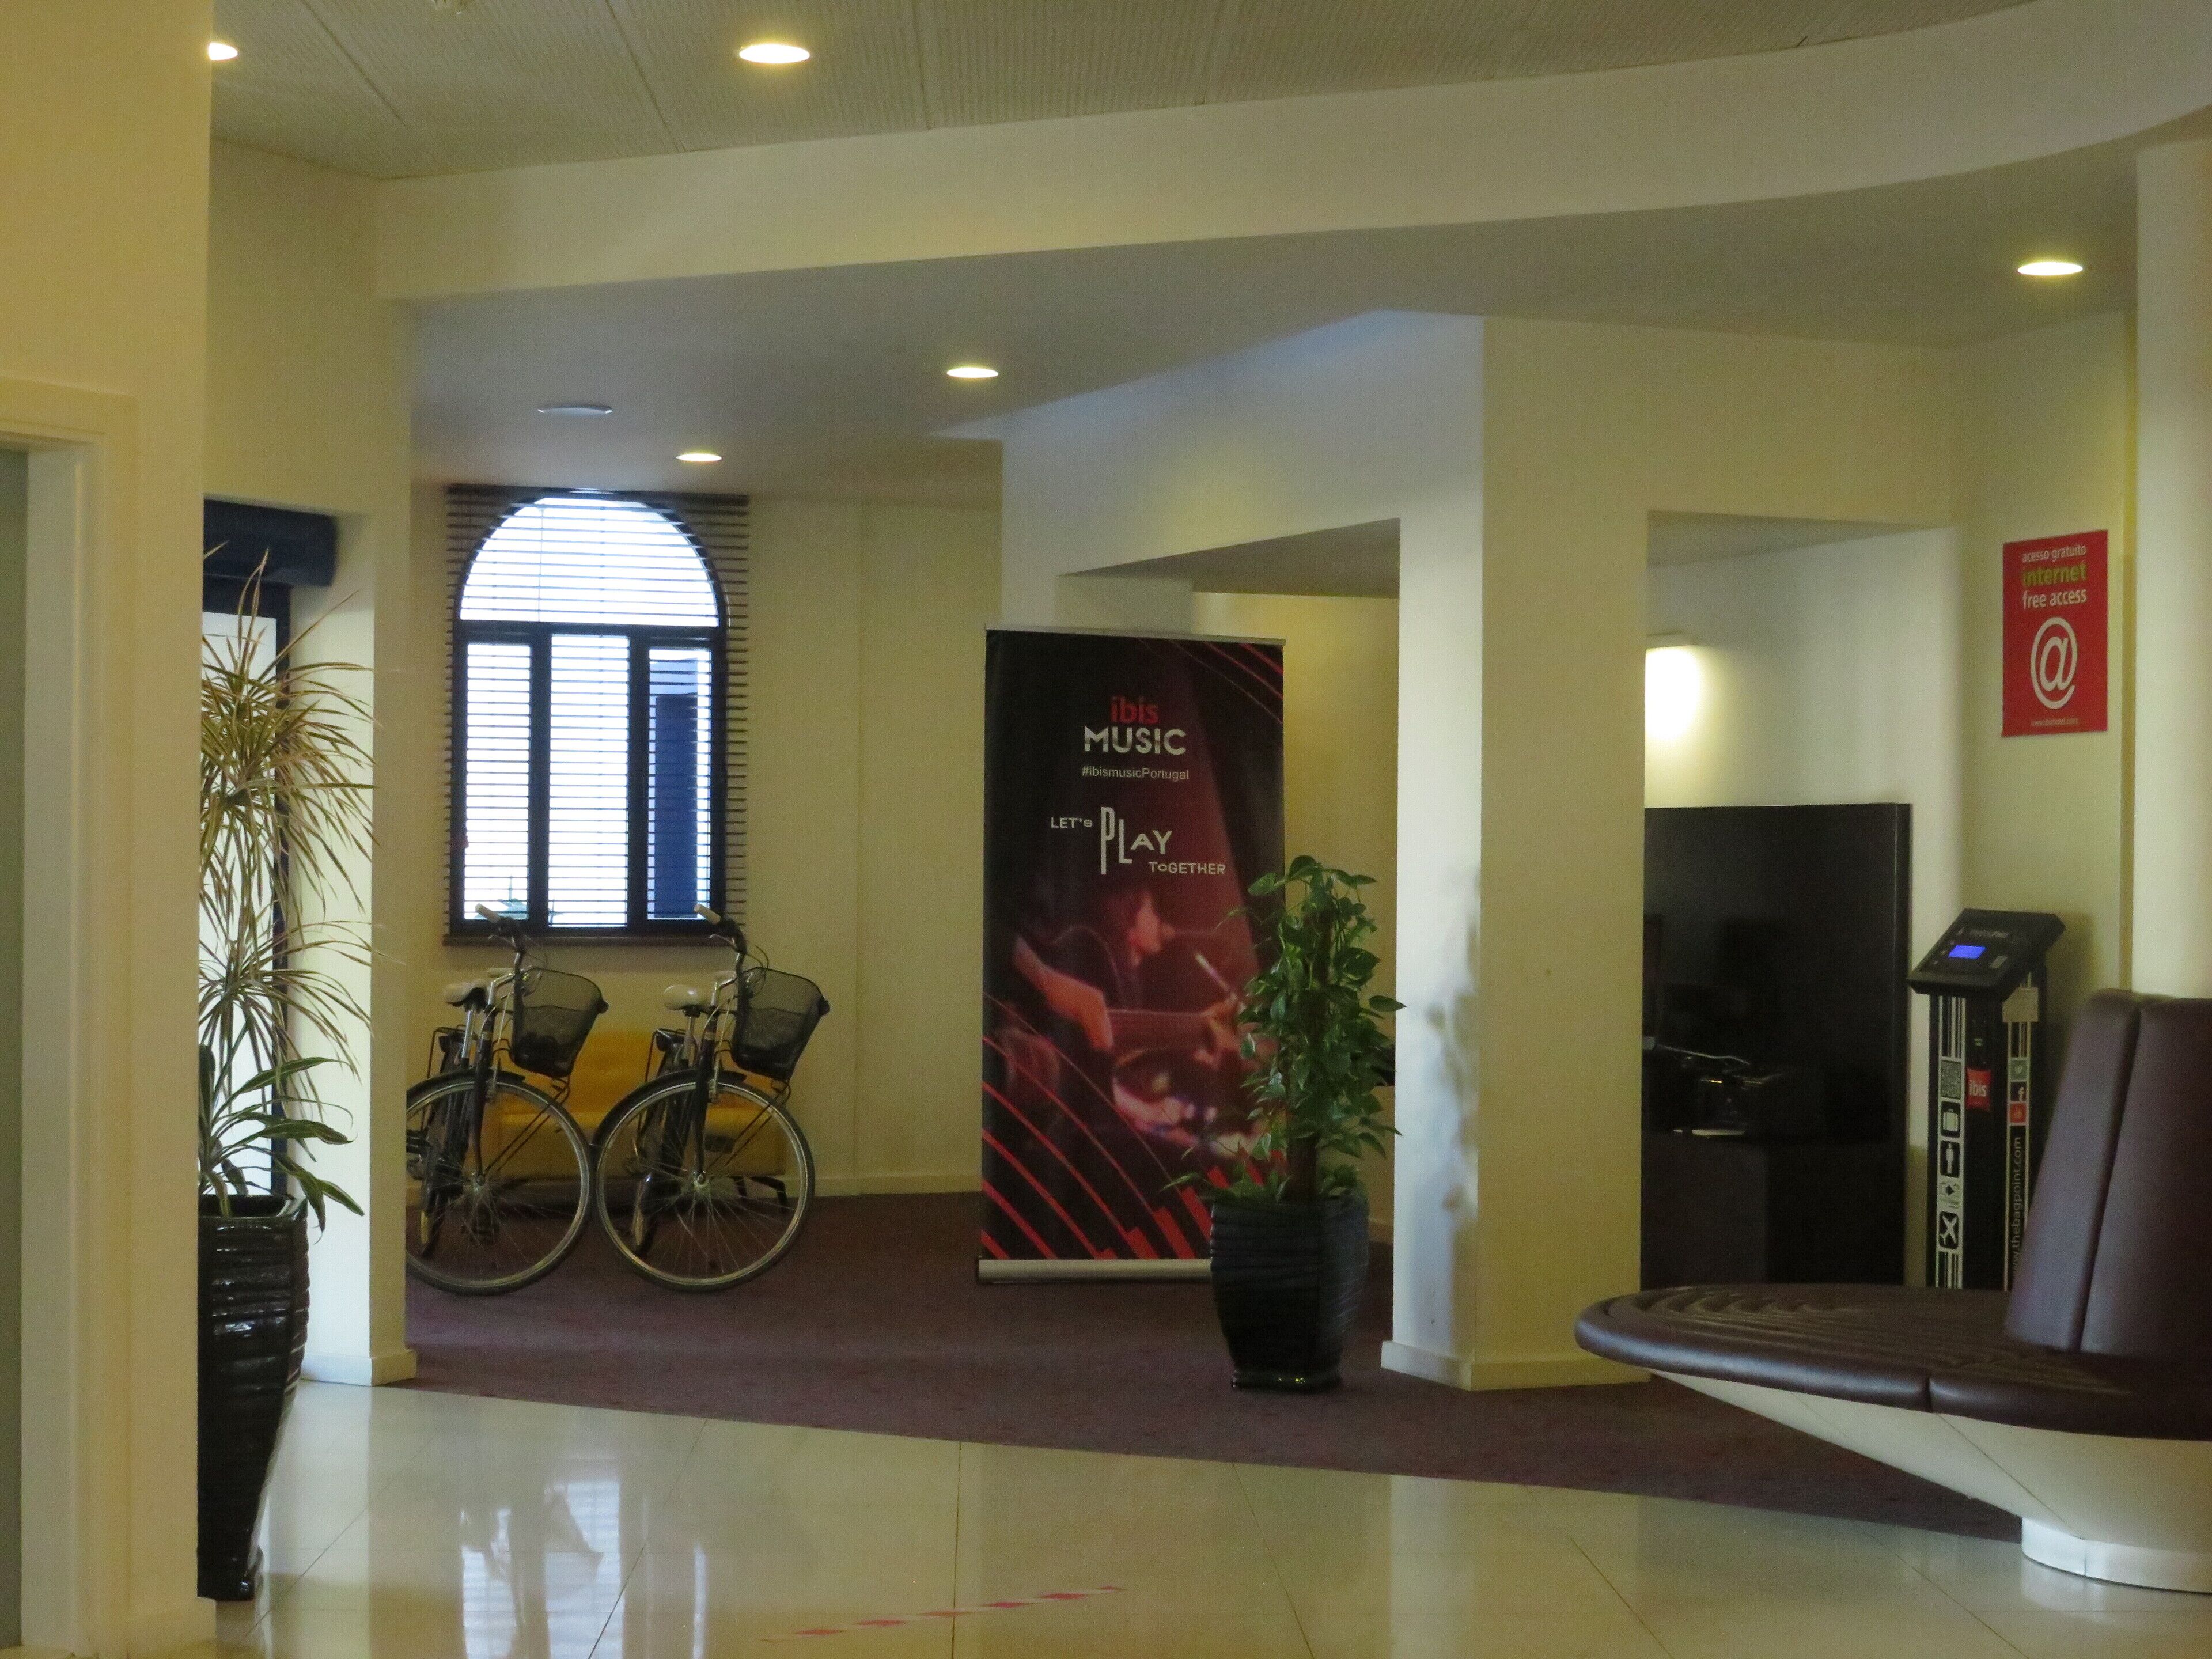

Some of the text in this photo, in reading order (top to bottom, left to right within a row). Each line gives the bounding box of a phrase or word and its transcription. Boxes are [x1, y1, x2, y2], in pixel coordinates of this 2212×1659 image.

[2022, 545, 2087, 563] acesso gratuito
[2023, 563, 2087, 586] internet
[2023, 589, 2087, 609] free access
[2031, 617, 2078, 709] @
[1111, 695, 1160, 724] ibis
[1084, 726, 1186, 755] MUSIC
[1081, 766, 1189, 782] #ibismusicPortugal
[1969, 1079, 1987, 1097] ibis
